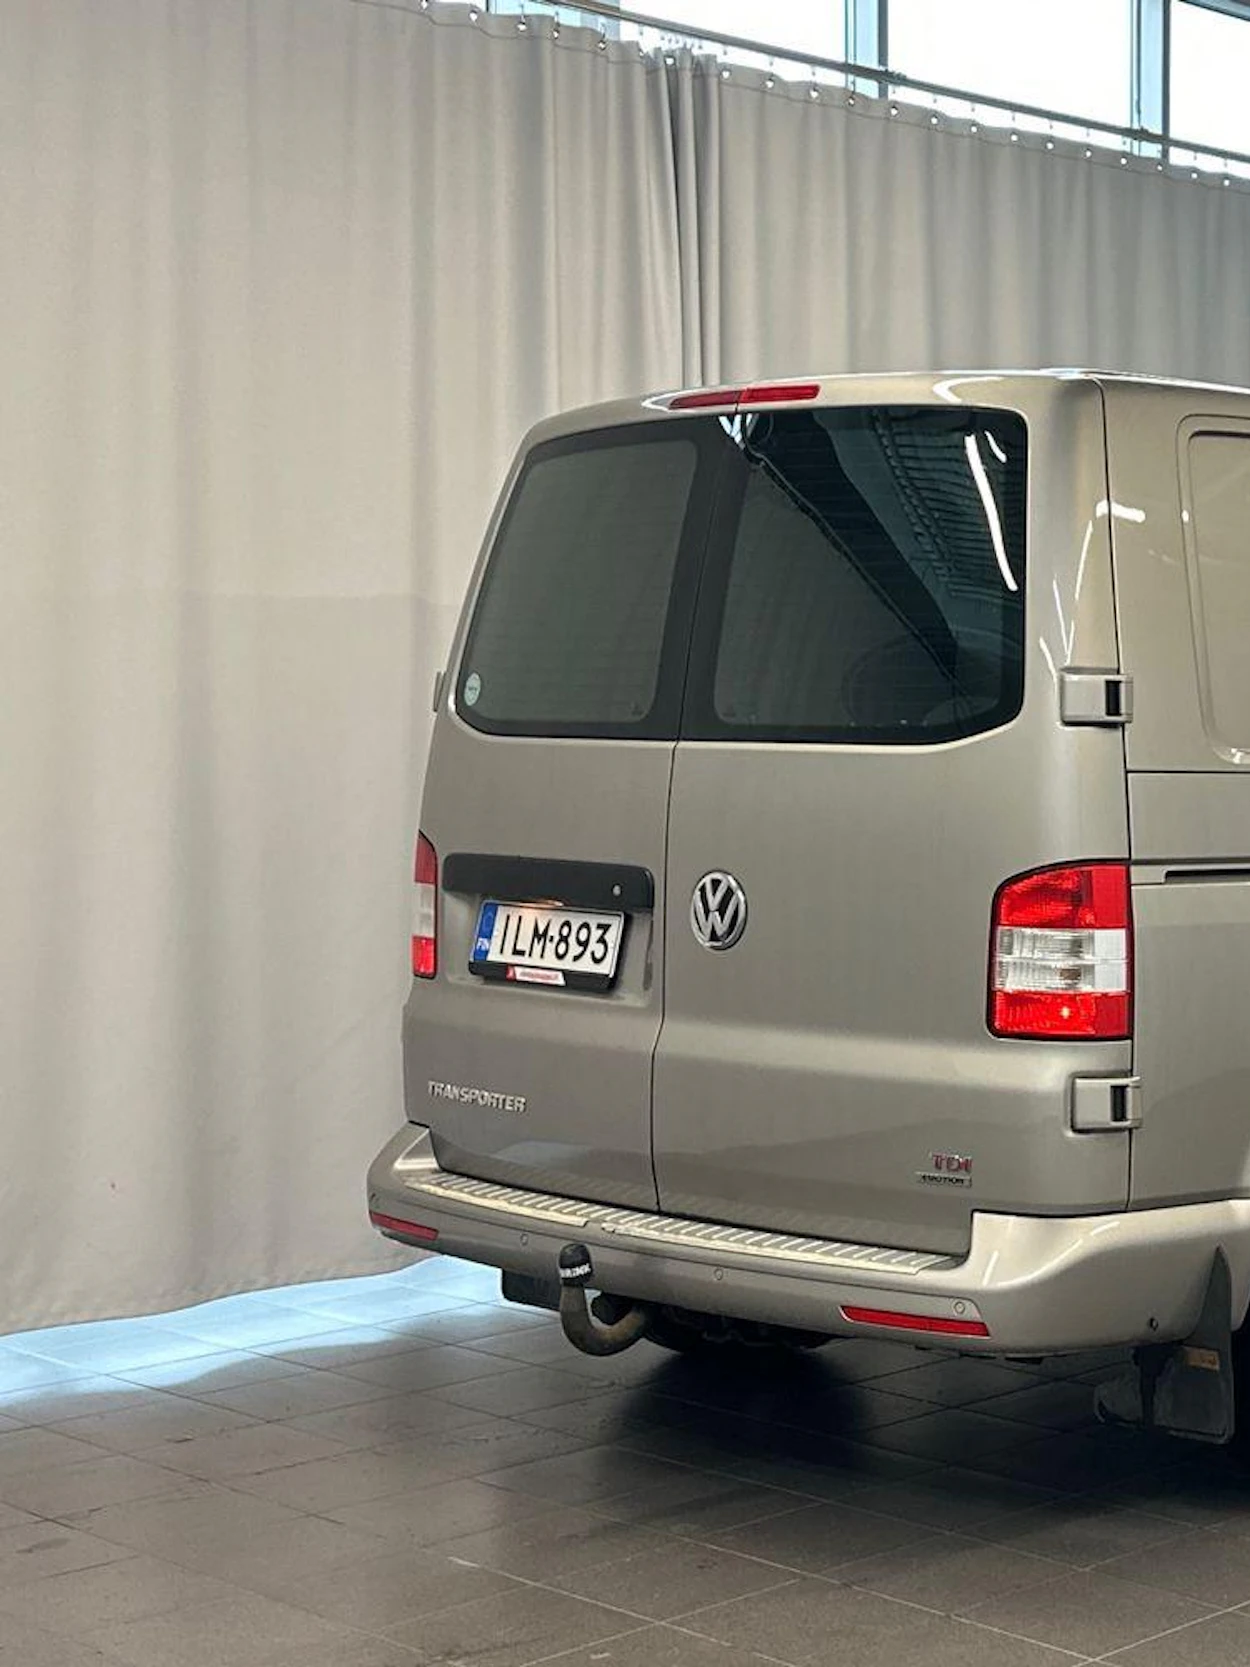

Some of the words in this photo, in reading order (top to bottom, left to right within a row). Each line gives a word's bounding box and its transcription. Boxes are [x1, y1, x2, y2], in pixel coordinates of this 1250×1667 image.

[499, 913, 612, 964] ILM-893
[427, 1080, 527, 1112] TRANSPORTER
[932, 1152, 973, 1172] TDI
